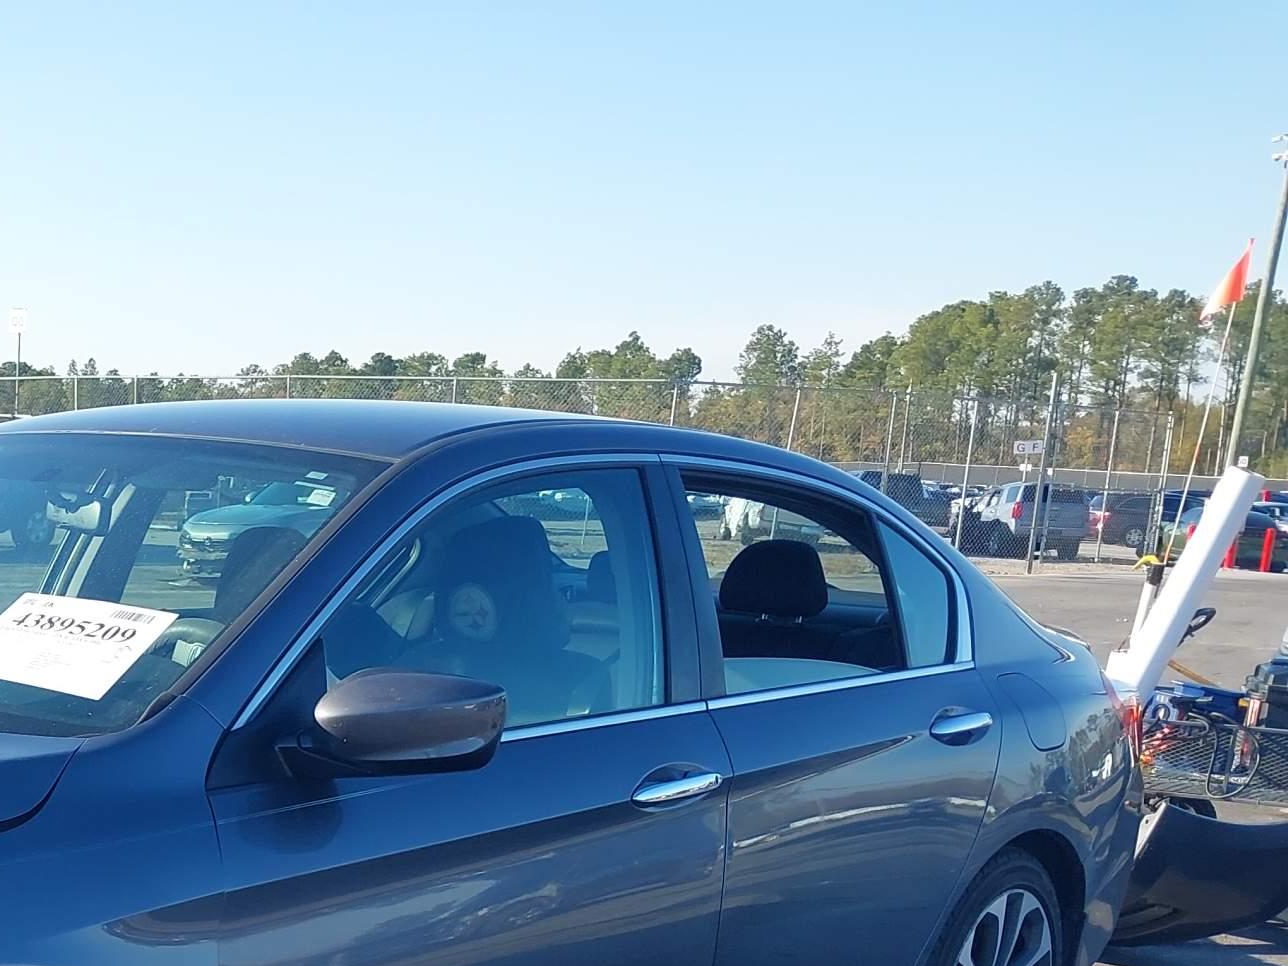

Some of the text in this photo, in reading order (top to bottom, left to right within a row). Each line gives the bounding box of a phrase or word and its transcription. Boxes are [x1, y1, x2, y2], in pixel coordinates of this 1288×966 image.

[1016, 442, 1039, 453] G F
[12, 612, 137, 643] 43895209
